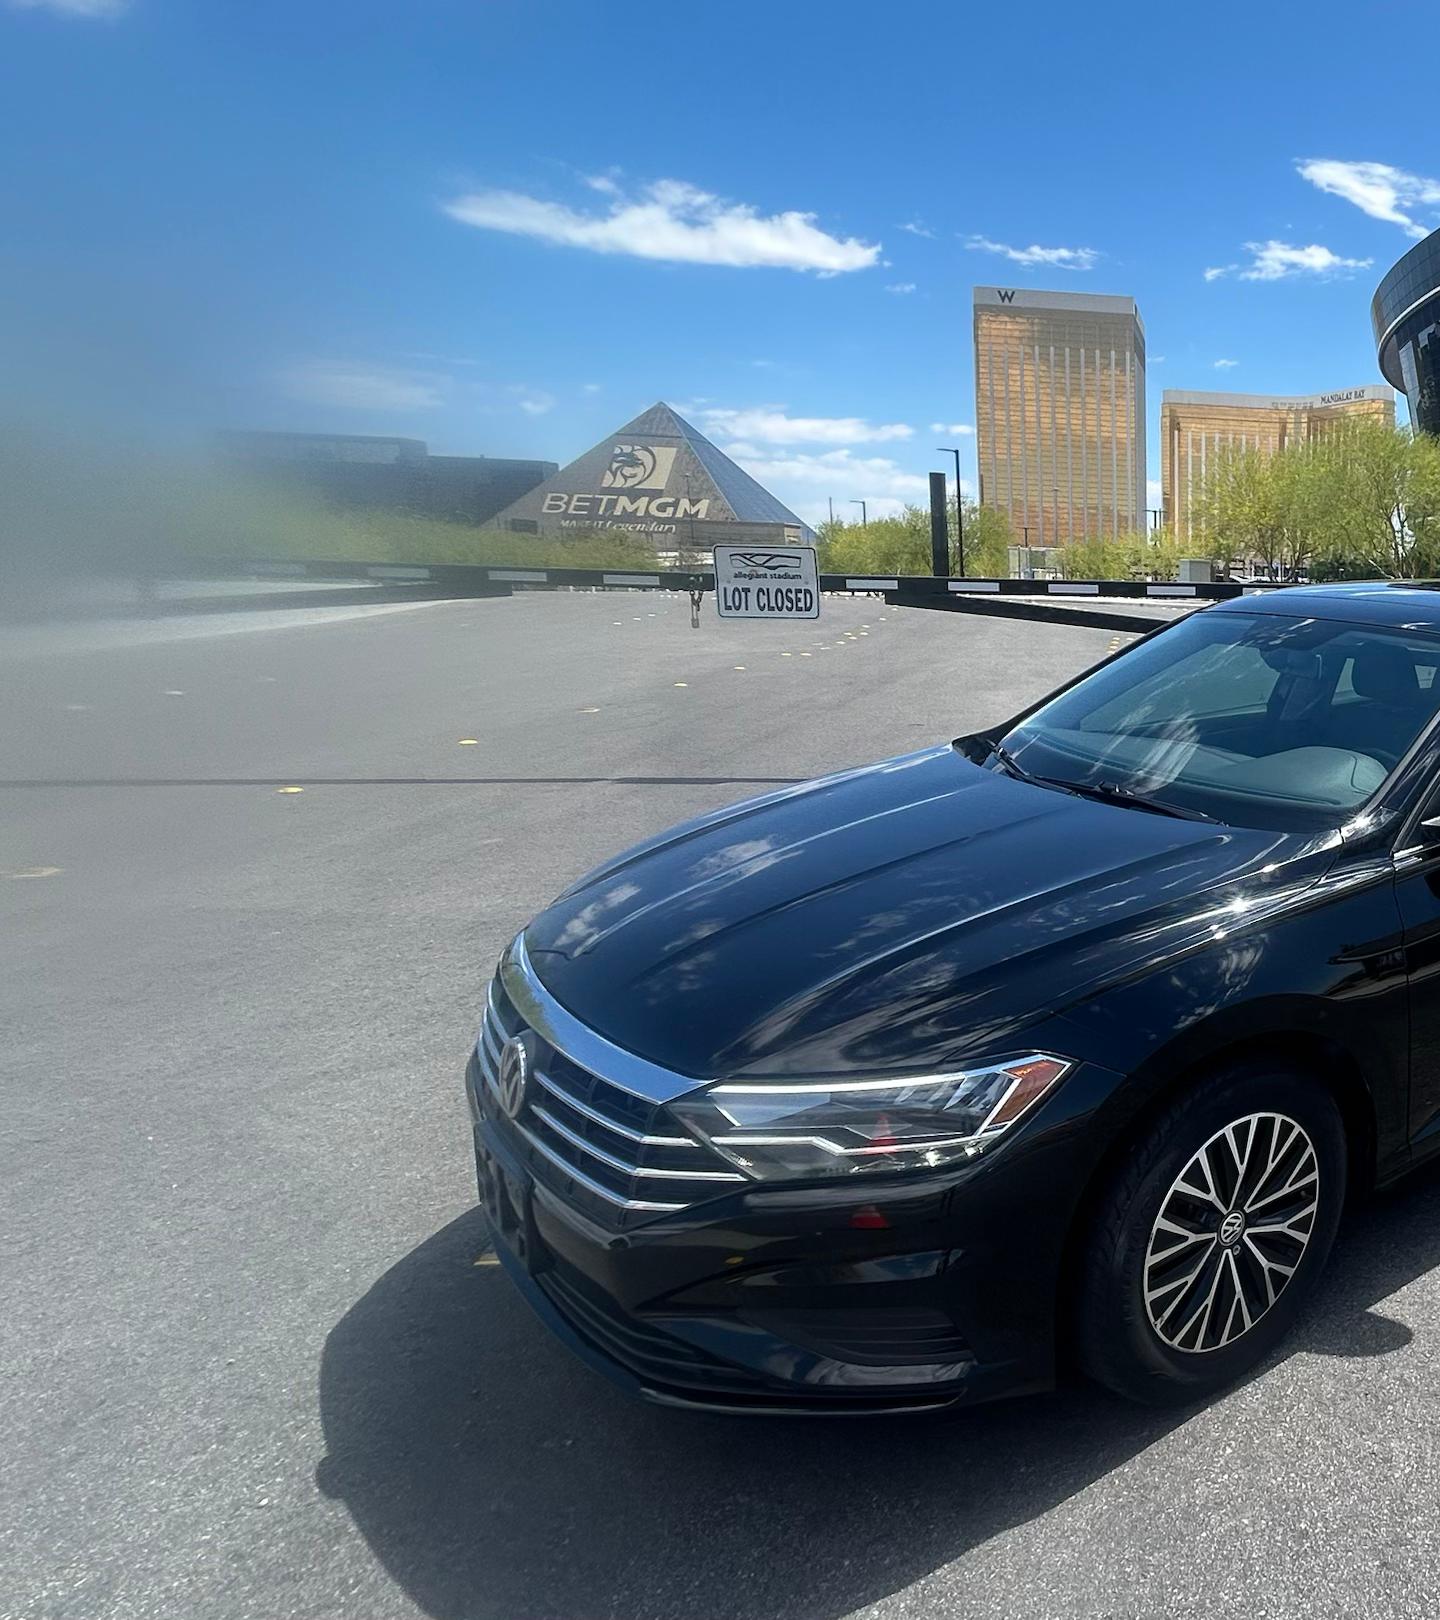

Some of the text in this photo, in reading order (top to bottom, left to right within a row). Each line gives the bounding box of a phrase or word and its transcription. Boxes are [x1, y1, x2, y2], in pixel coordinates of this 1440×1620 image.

[997, 290, 1016, 304] W
[541, 492, 710, 519] BETMGM
[723, 586, 813, 612] LOT CLOSED
